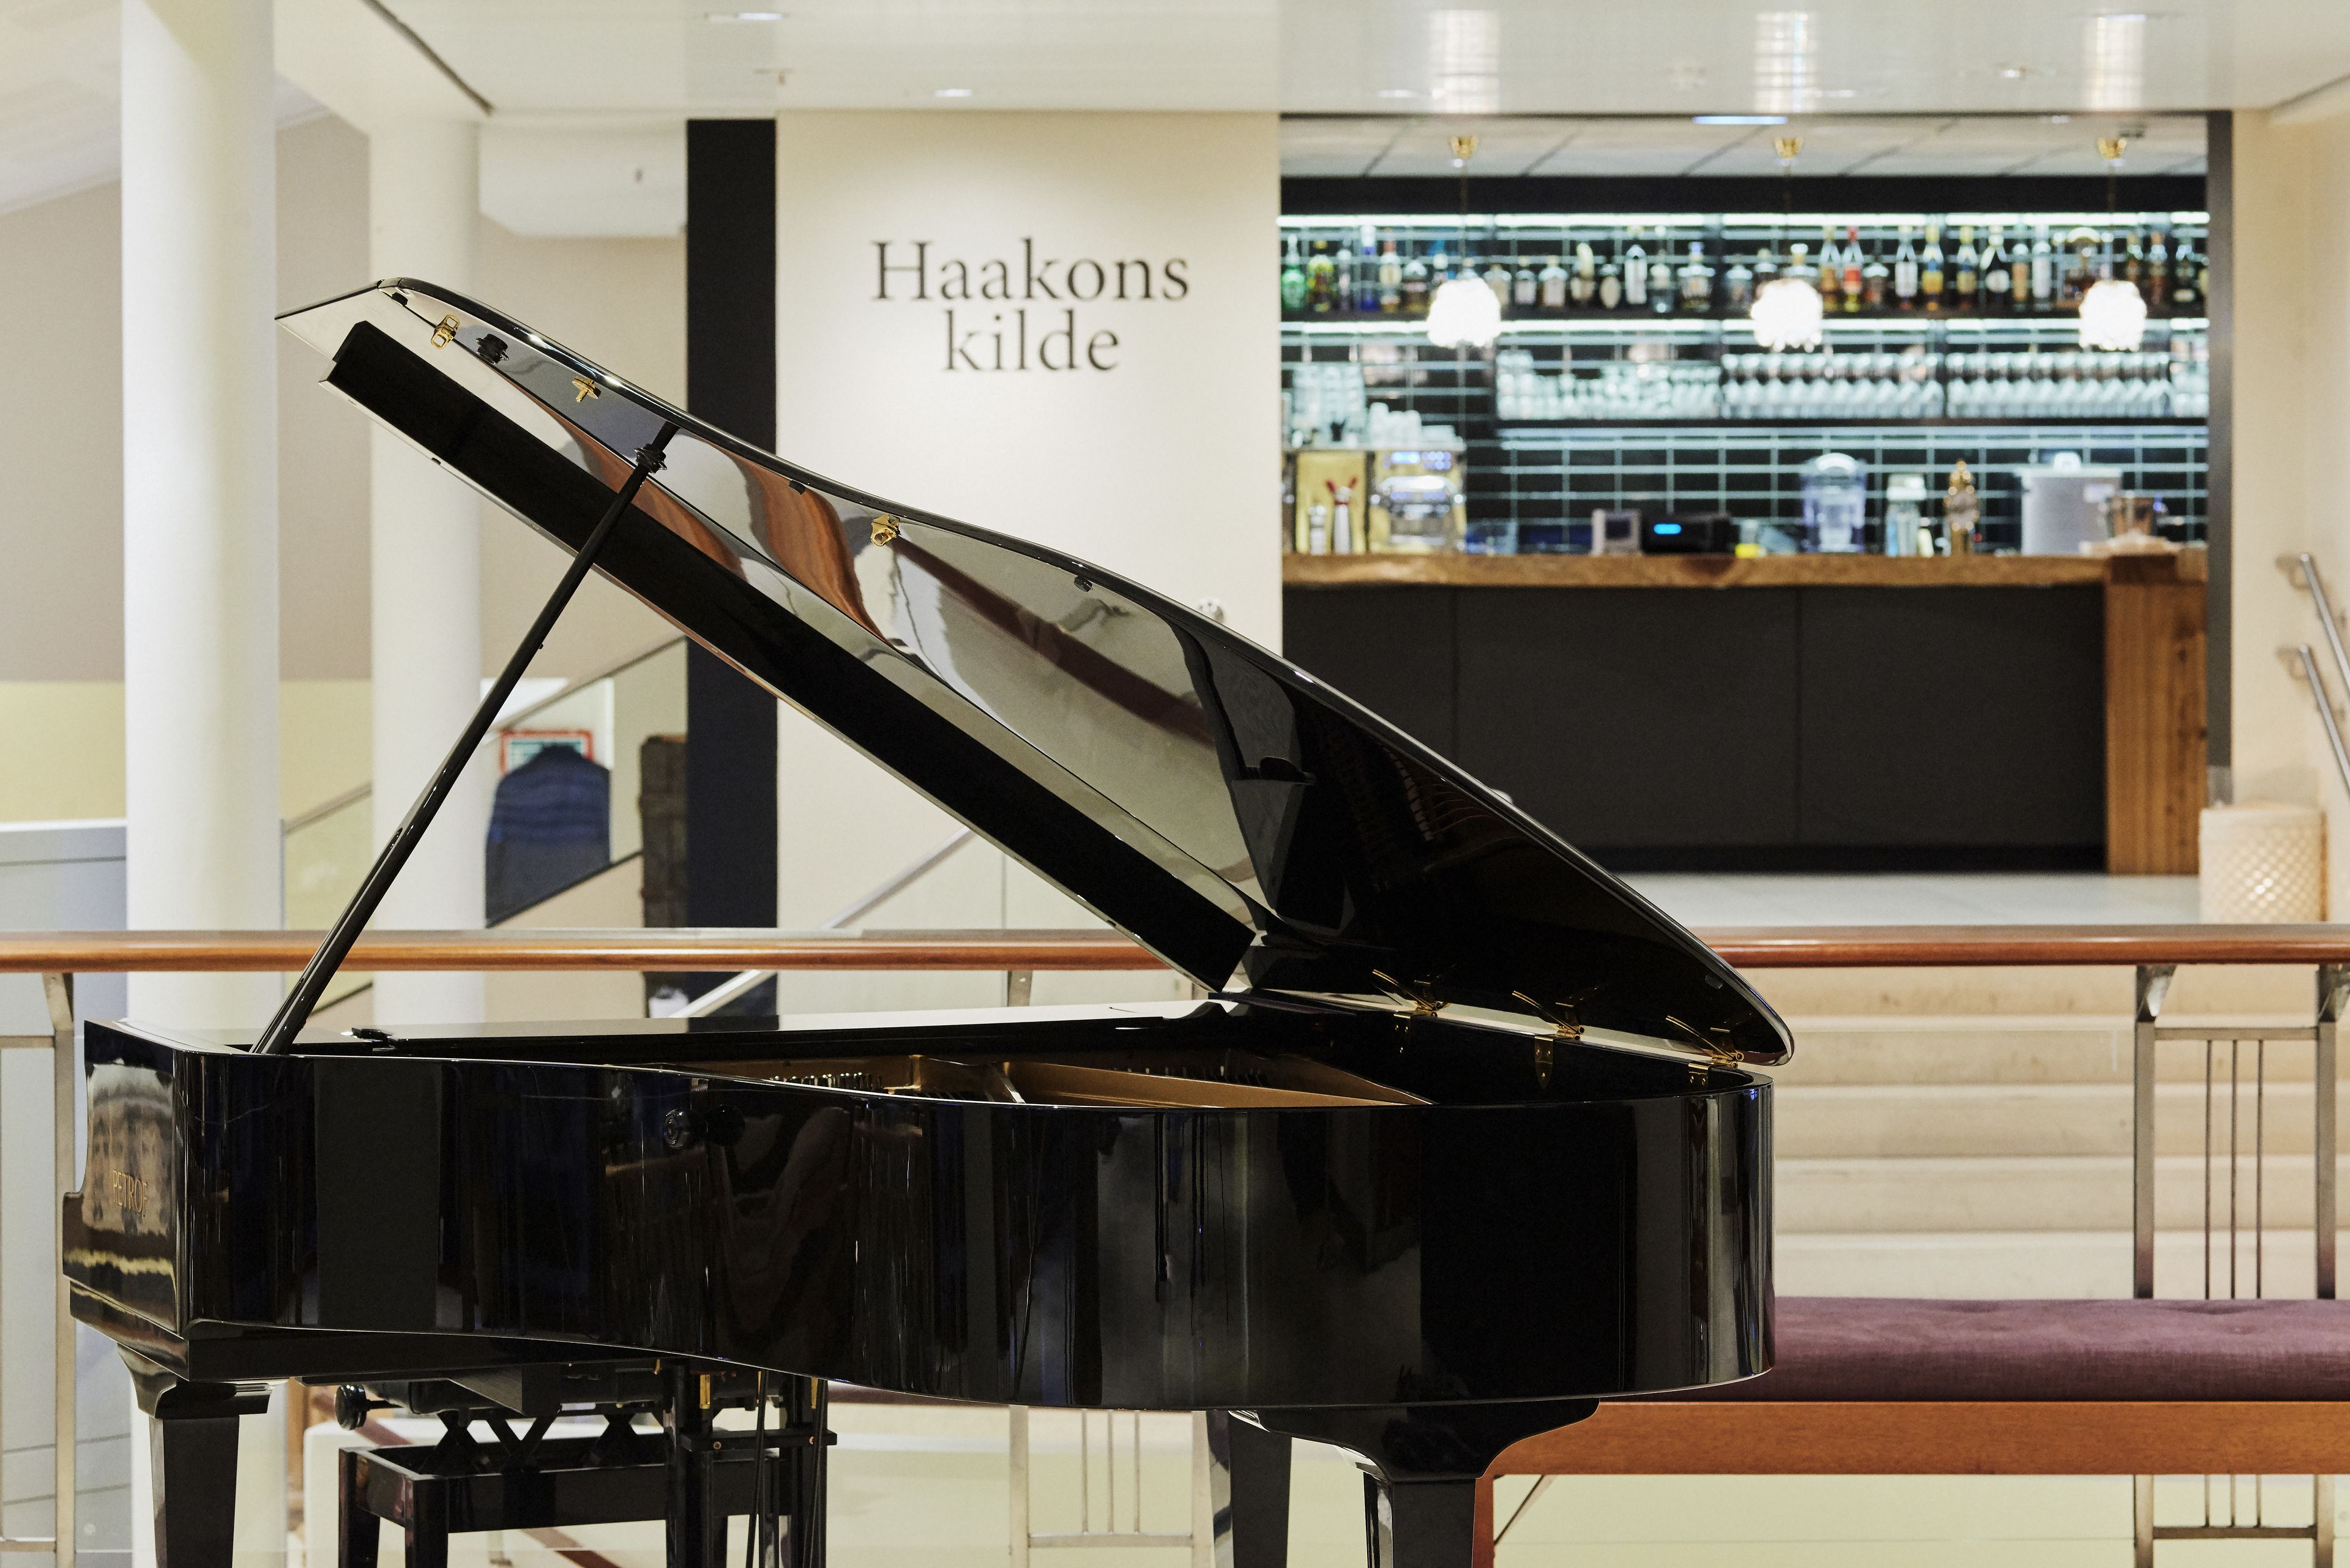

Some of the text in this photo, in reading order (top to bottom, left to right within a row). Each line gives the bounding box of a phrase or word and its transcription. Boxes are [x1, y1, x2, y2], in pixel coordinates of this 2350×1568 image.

[872, 236, 1190, 301] Haakons
[944, 308, 1119, 371] kilde
[113, 1170, 147, 1216] PETROF
